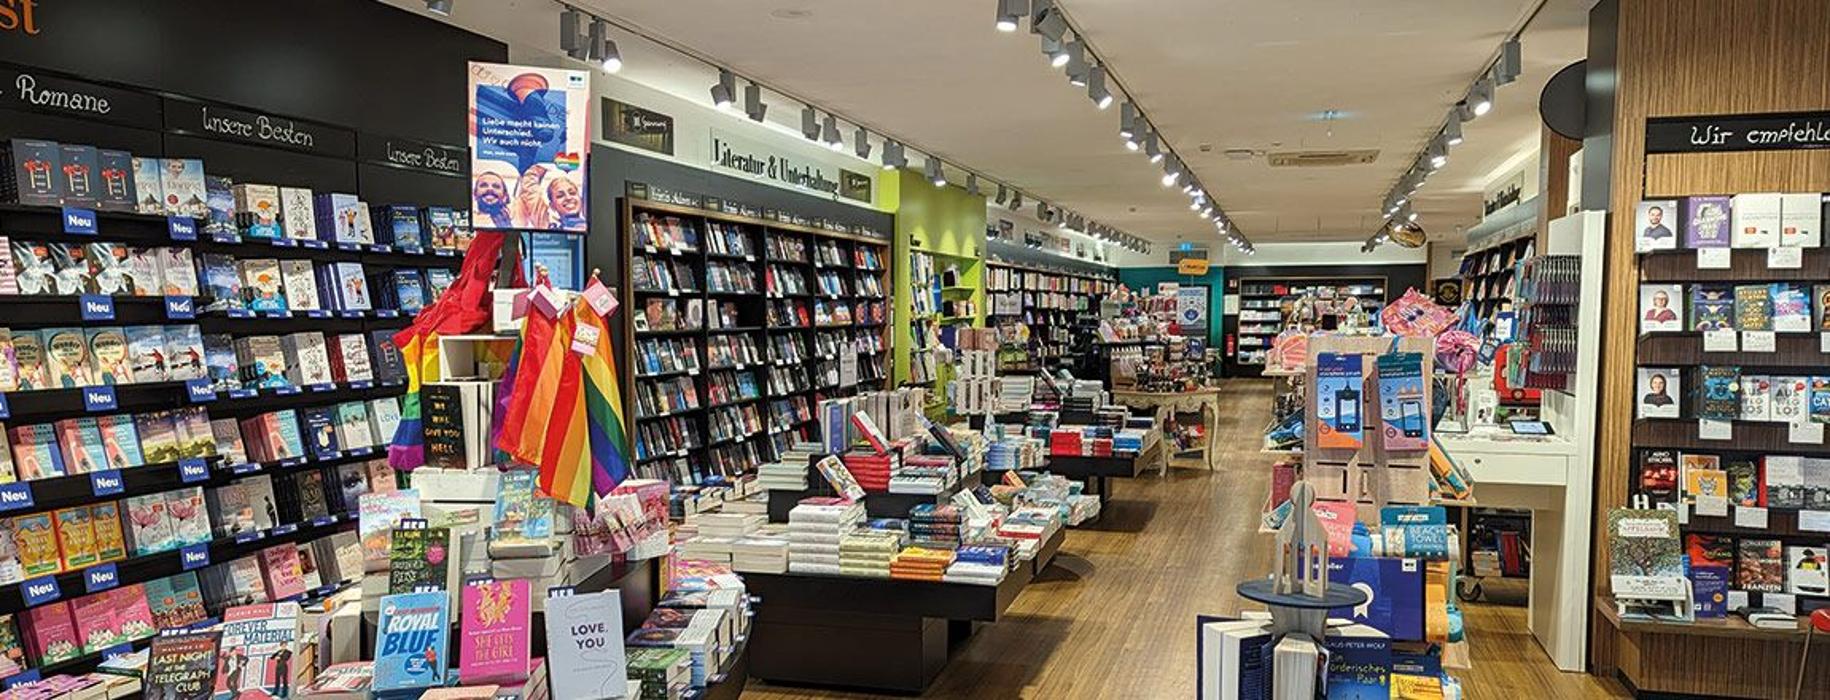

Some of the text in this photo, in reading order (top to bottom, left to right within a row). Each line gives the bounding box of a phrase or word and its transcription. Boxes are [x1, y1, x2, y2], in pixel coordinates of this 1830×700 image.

[16, 74, 111, 113] Romane
[202, 106, 313, 147] Unsere Besten
[483, 118, 560, 129] Liebe macht keinen
[482, 128, 534, 137] Unterschied.
[1691, 125, 1733, 145] Wir
[483, 137, 497, 145] Wir
[500, 138, 519, 147] auch
[423, 148, 459, 171] Besten
[713, 138, 839, 200] Literatur & Unterhaltung
[68, 215, 92, 227] Neu
[173, 222, 193, 234] Neu
[86, 301, 109, 313] Neu
[88, 393, 112, 403] Neu
[431, 443, 455, 454] HELL
[183, 464, 204, 475] Neu
[96, 478, 119, 488] Neu
[1, 490, 28, 502] Neu
[1409, 525, 1445, 535] BEACH
[185, 551, 206, 562] Neu
[91, 572, 114, 583] Neu
[29, 585, 54, 597] Neu
[1742, 583, 1782, 591] FRANZEN
[387, 612, 440, 634] ROYAL
[244, 628, 295, 644] MATERIAL
[382, 630, 440, 656] BLUE
[576, 637, 605, 649] YOU
[154, 655, 176, 665] LAST
[155, 670, 211, 684] TELEGRAPH
[175, 681, 201, 694] CLUB
